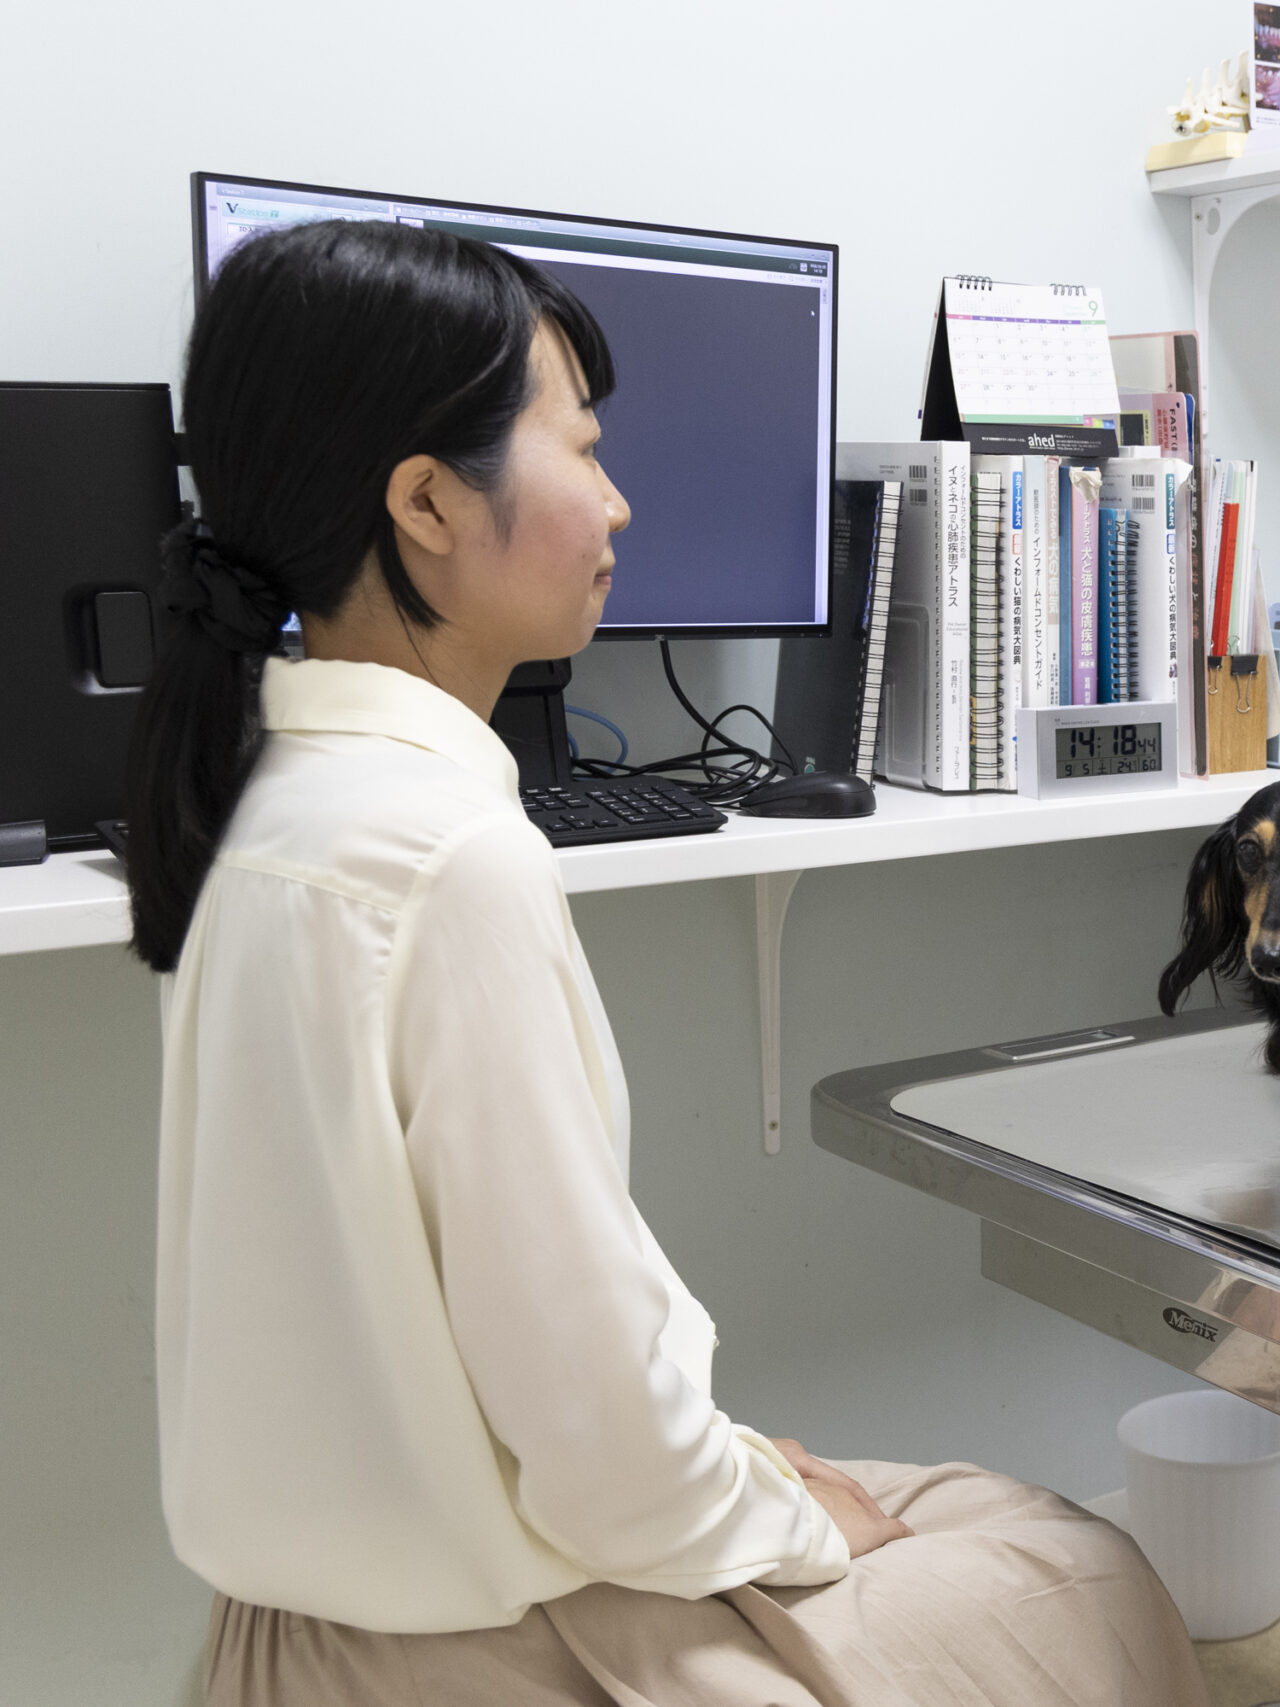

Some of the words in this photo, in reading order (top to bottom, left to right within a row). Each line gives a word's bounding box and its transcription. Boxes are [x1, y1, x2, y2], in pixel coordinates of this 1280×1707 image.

[1088, 300, 1098, 317] 9
[1027, 433, 1055, 448] ahed
[947, 465, 959, 607] イヌとネコの心肺疾患アトラス
[1013, 556, 1022, 665] くわしい猫の病気大図典
[1070, 724, 1137, 758] 14:18
[1137, 738, 1156, 753] 44
[1065, 764, 1073, 776] 9
[1082, 763, 1090, 775] 5
[1142, 759, 1156, 771] 60
